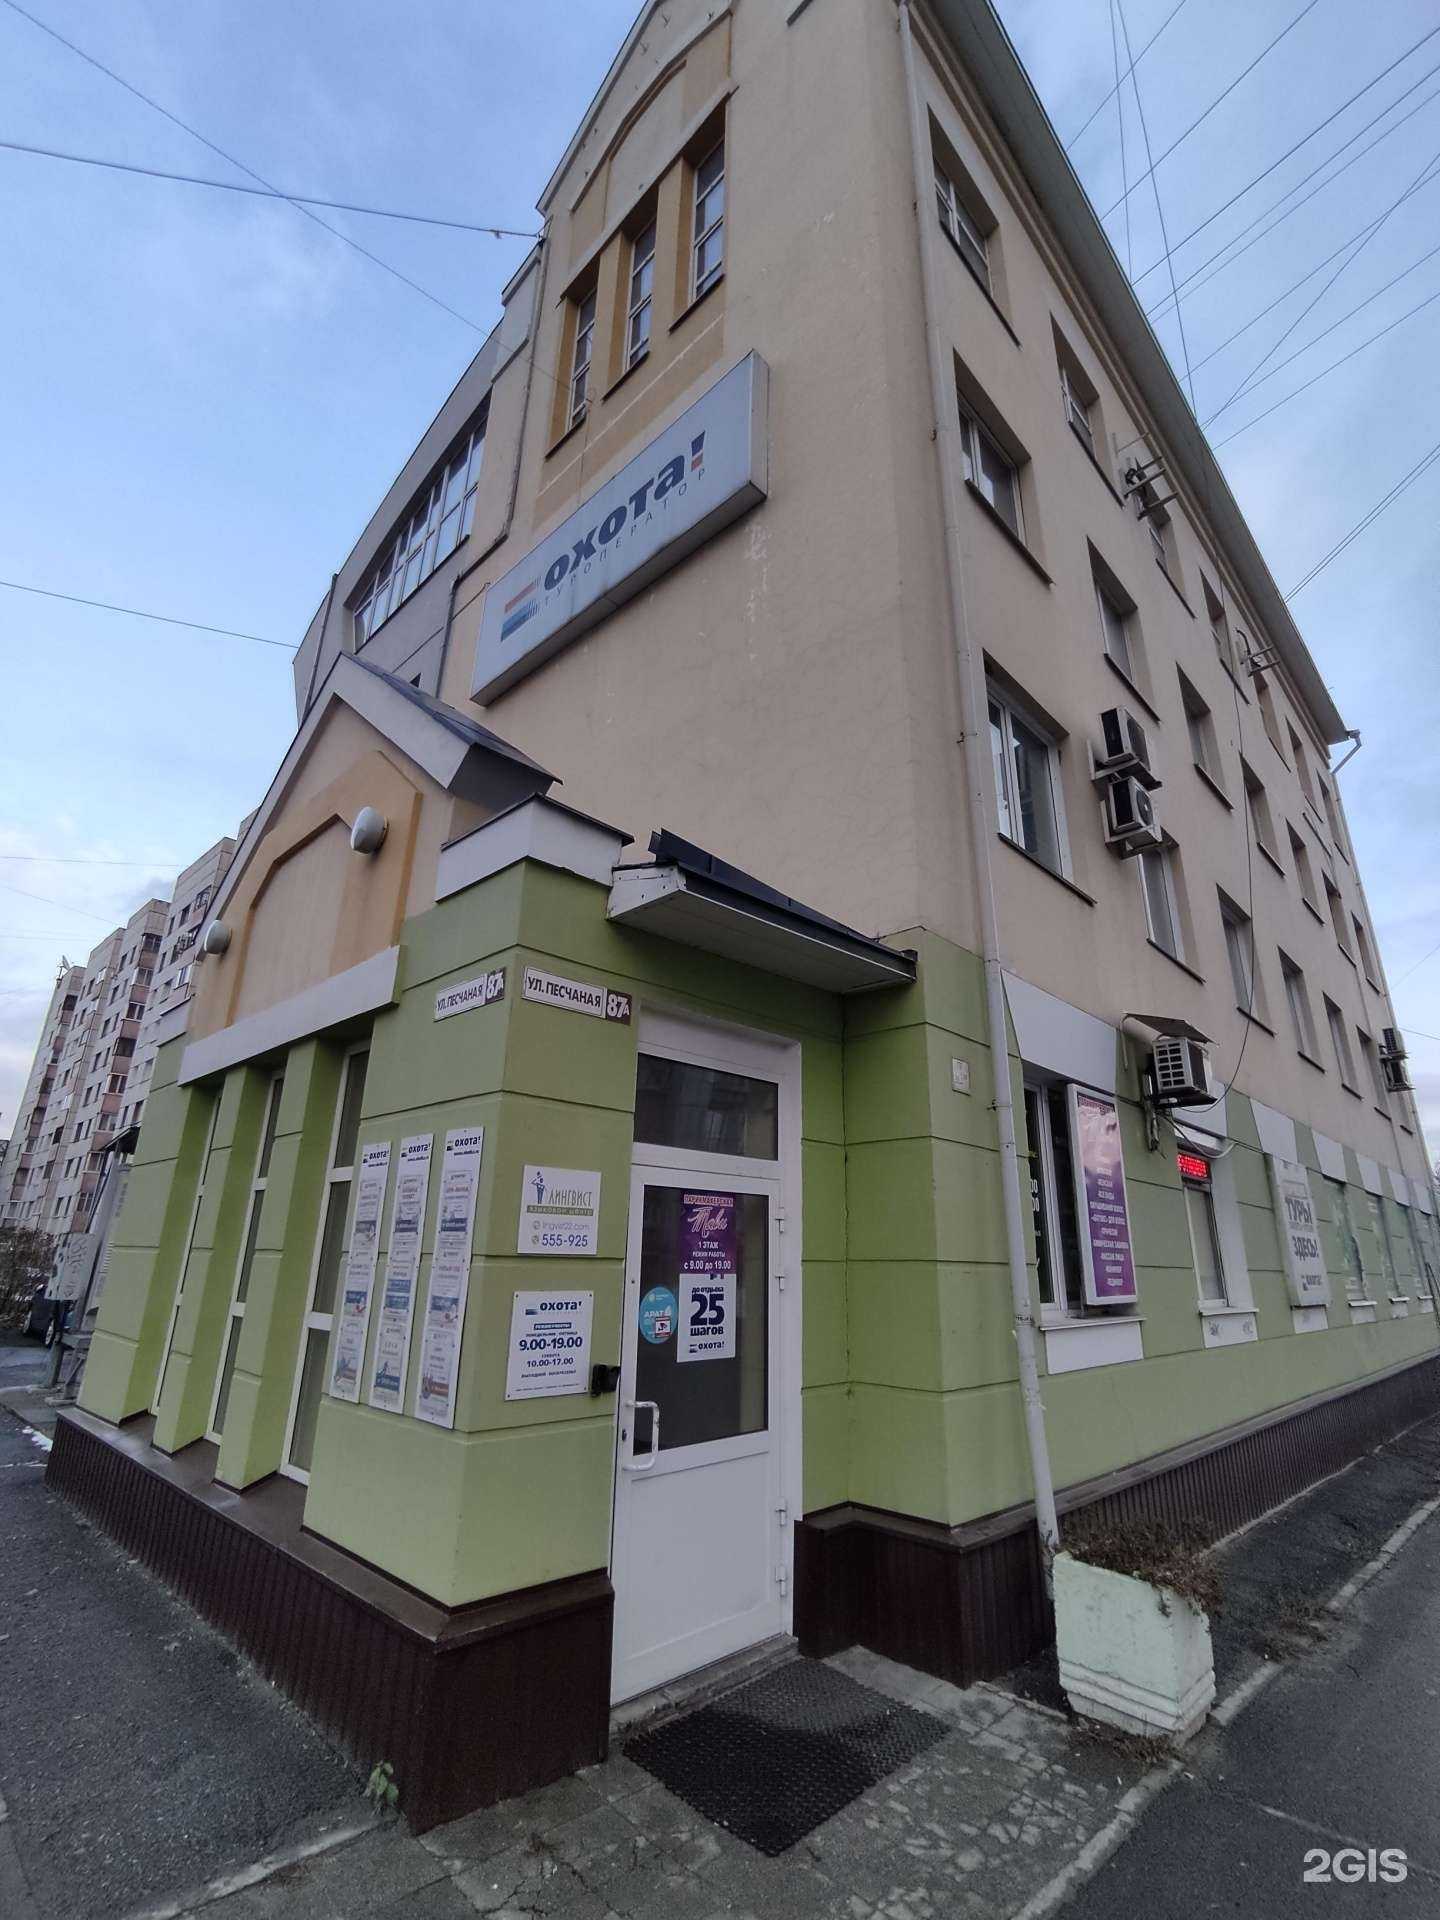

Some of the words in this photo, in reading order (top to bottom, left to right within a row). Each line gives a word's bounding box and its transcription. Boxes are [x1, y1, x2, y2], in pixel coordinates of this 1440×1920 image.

[544, 430, 706, 591] охота!
[447, 985, 483, 1006] ПЕСЧАНАЯ
[528, 976, 545, 993] УЛ.
[547, 983, 601, 1009] ПЕСЧАНАЯ
[548, 1189, 592, 1207] ЛИНГВИСТ
[542, 1233, 588, 1247] 555-925
[703, 1241, 719, 1249] ЭТАЖ
[705, 1262, 713, 1271] до
[690, 1293, 725, 1326] 25
[690, 1326, 724, 1337] шагов
[519, 1337, 583, 1351] 9.00-19.00
[527, 1357, 574, 1368] 10.00-17.00
